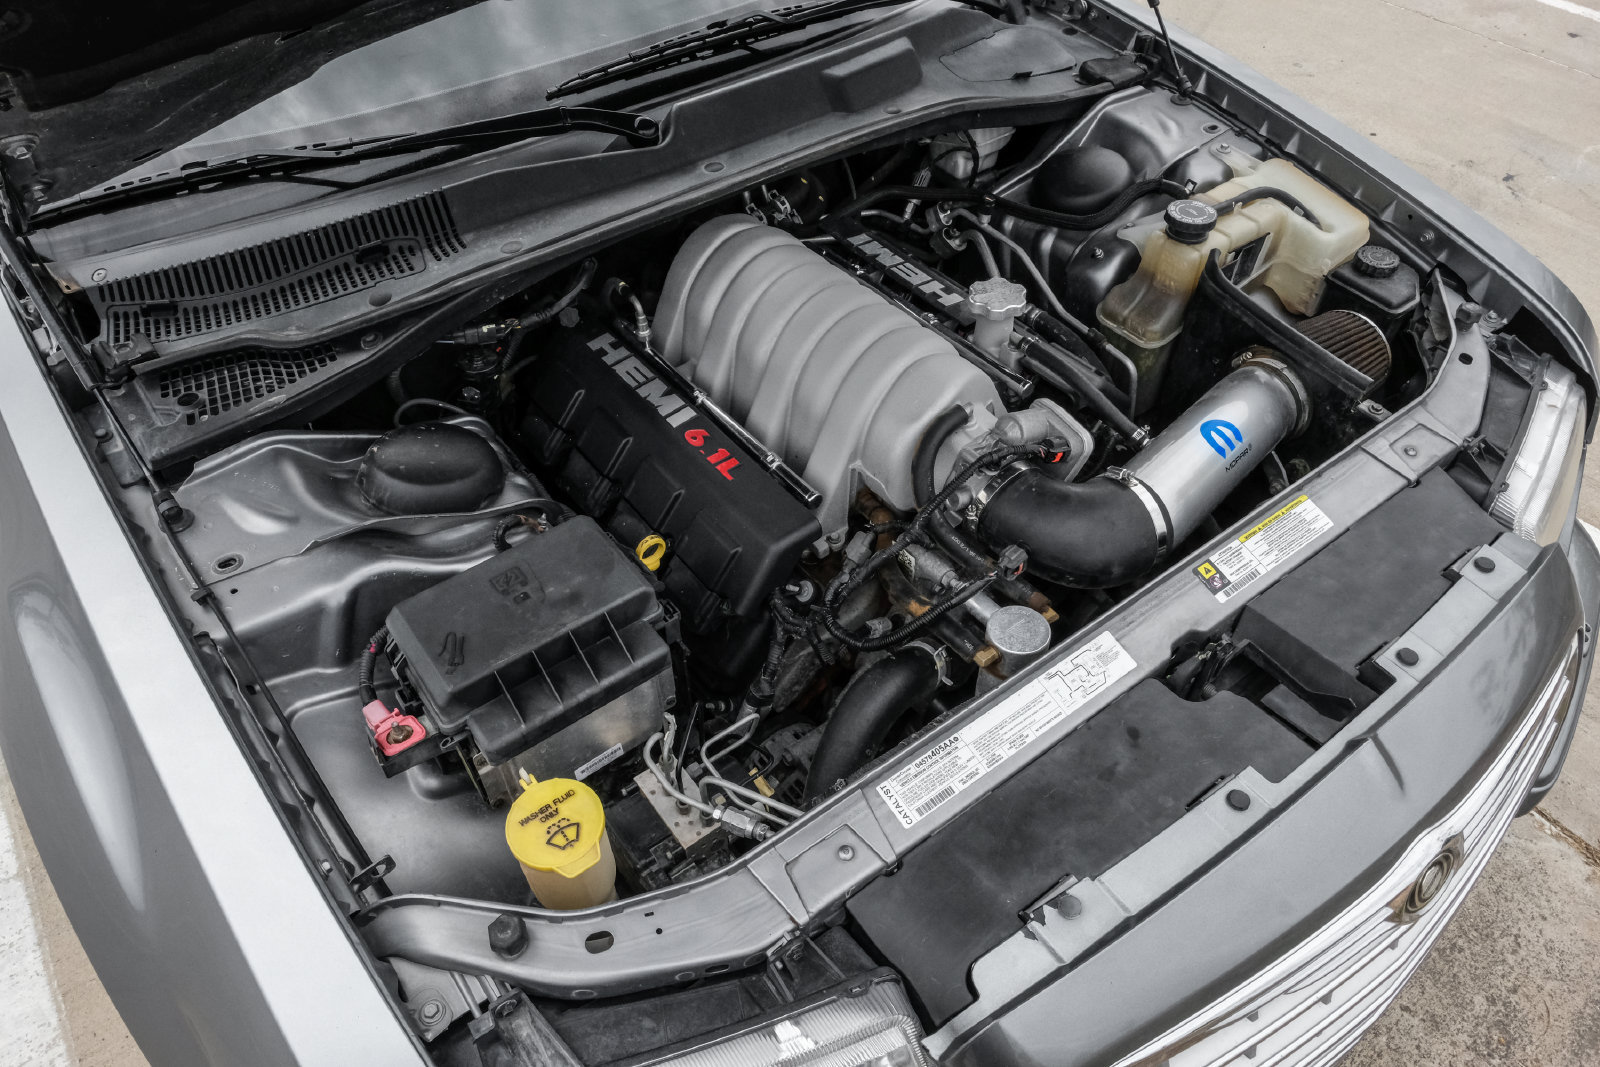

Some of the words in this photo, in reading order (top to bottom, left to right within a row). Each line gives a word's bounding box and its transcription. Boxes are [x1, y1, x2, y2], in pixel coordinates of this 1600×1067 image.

[847, 233, 965, 306] HEMI
[586, 332, 697, 428] HEMI
[684, 428, 740, 481] 6.1L
[519, 803, 553, 827] WASHER
[552, 789, 576, 806] FLUID
[539, 807, 559, 823] ONLY
[880, 785, 913, 825] CATALYST
